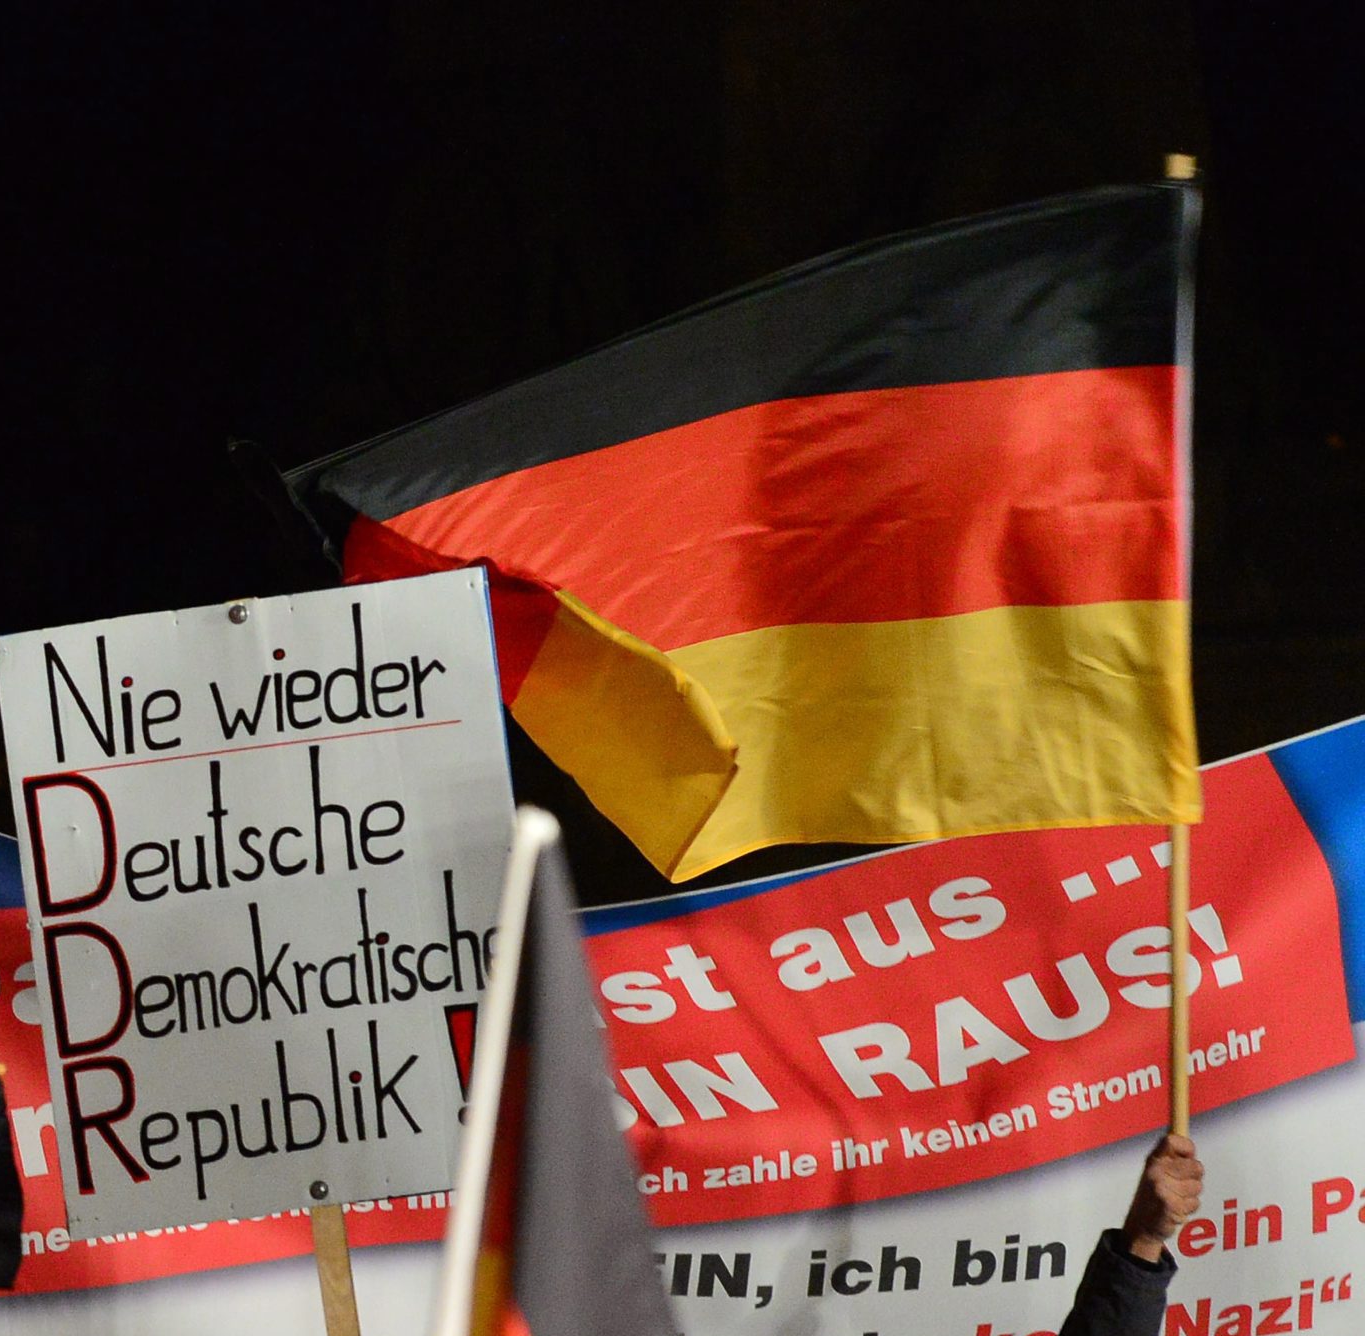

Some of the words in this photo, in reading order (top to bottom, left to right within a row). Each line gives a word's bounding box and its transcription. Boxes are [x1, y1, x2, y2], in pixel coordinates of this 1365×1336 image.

[44, 636, 182, 762] Nie
[210, 603, 446, 740] wieder
[23, 746, 405, 917] Deutsche
[595, 943, 737, 1028] st
[770, 876, 1007, 991] aus
[613, 1052, 779, 1131] IN
[818, 903, 1243, 1099] RAUS!
[63, 1020, 422, 1200] Republik
[637, 1167, 689, 1194] ch
[703, 1150, 818, 1189] zahle
[831, 1138, 889, 1171] ihr
[900, 1103, 1038, 1159] keinen
[1046, 1064, 1162, 1120] Strom
[655, 1252, 774, 1309] IN,
[807, 1249, 922, 1298] ich
[952, 1234, 1067, 1287] bin
[1177, 1198, 1283, 1258] ein
[1311, 1176, 1365, 1235] P
